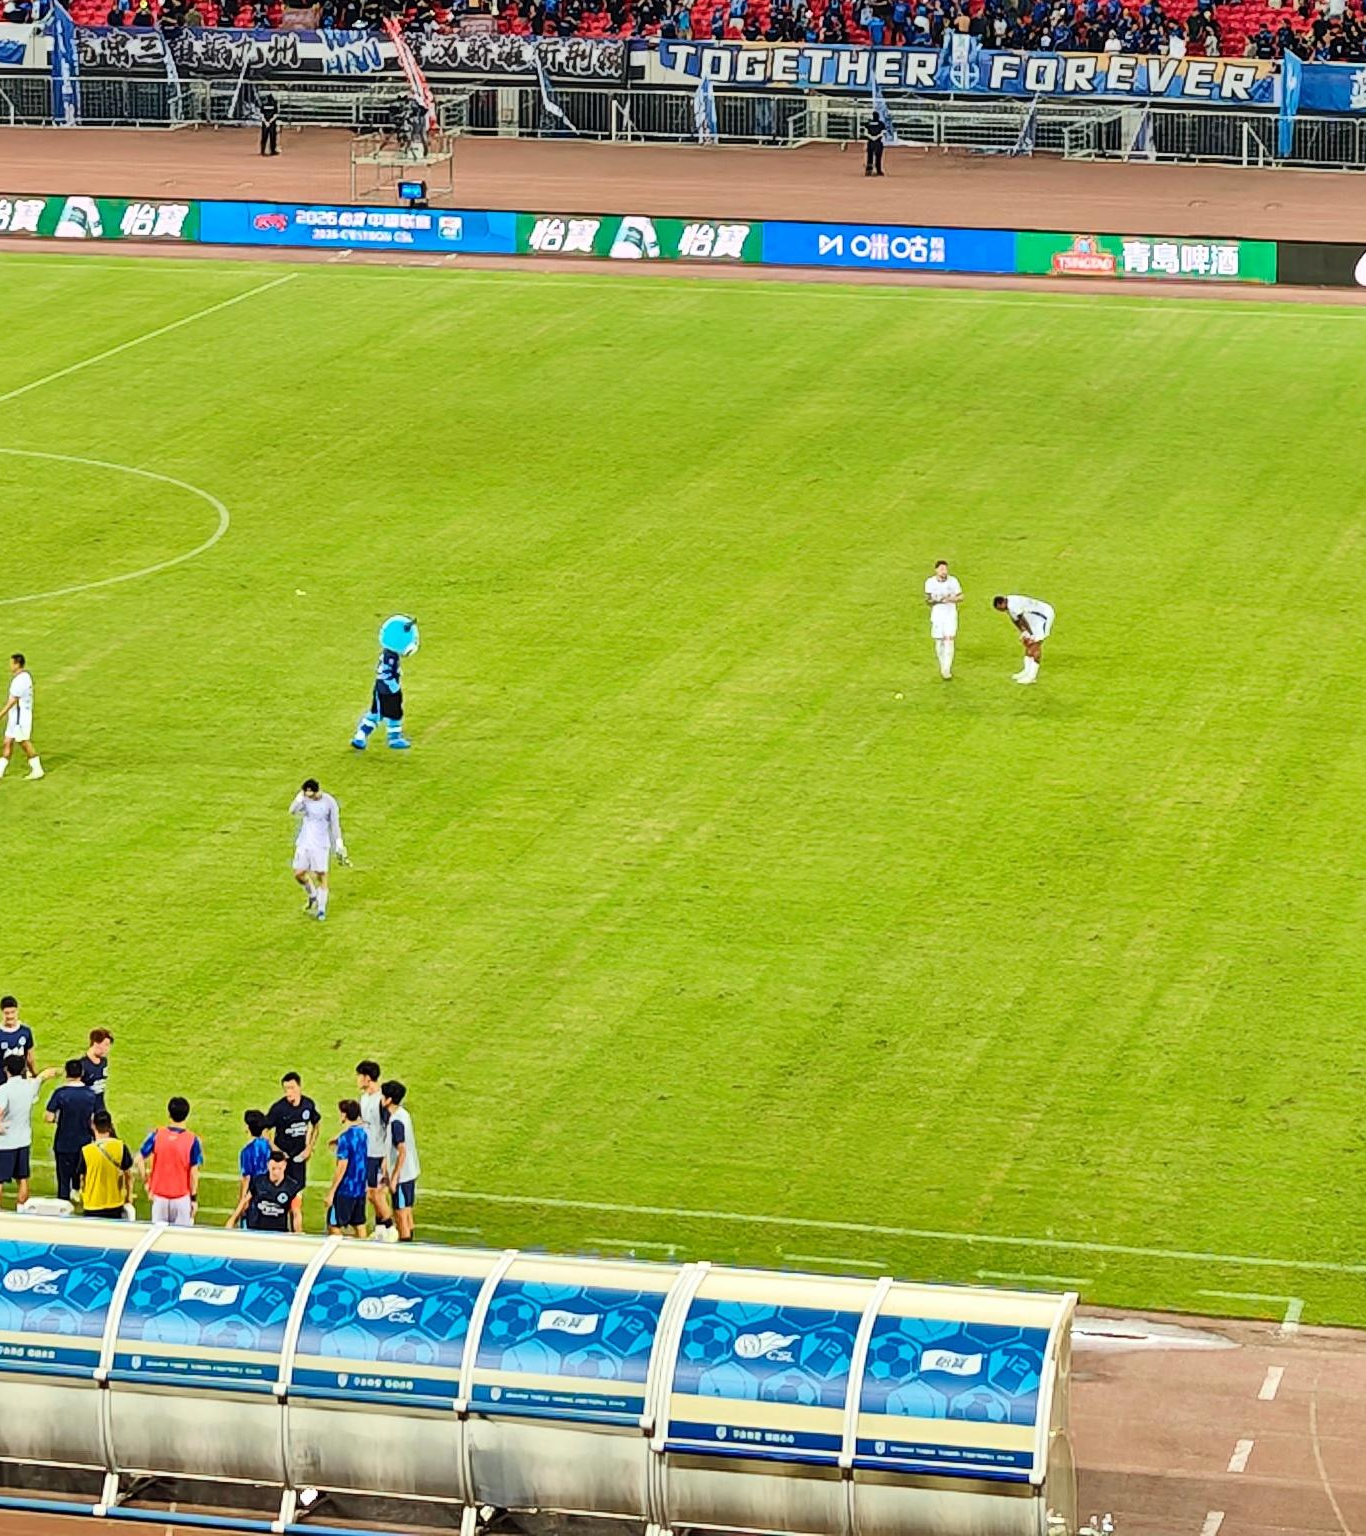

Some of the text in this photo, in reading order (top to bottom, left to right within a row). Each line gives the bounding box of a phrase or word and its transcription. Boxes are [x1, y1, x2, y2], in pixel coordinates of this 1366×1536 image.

[666, 43, 1259, 102] TOGETHER FOREVER
[1121, 240, 1241, 277] 青岛啤酒
